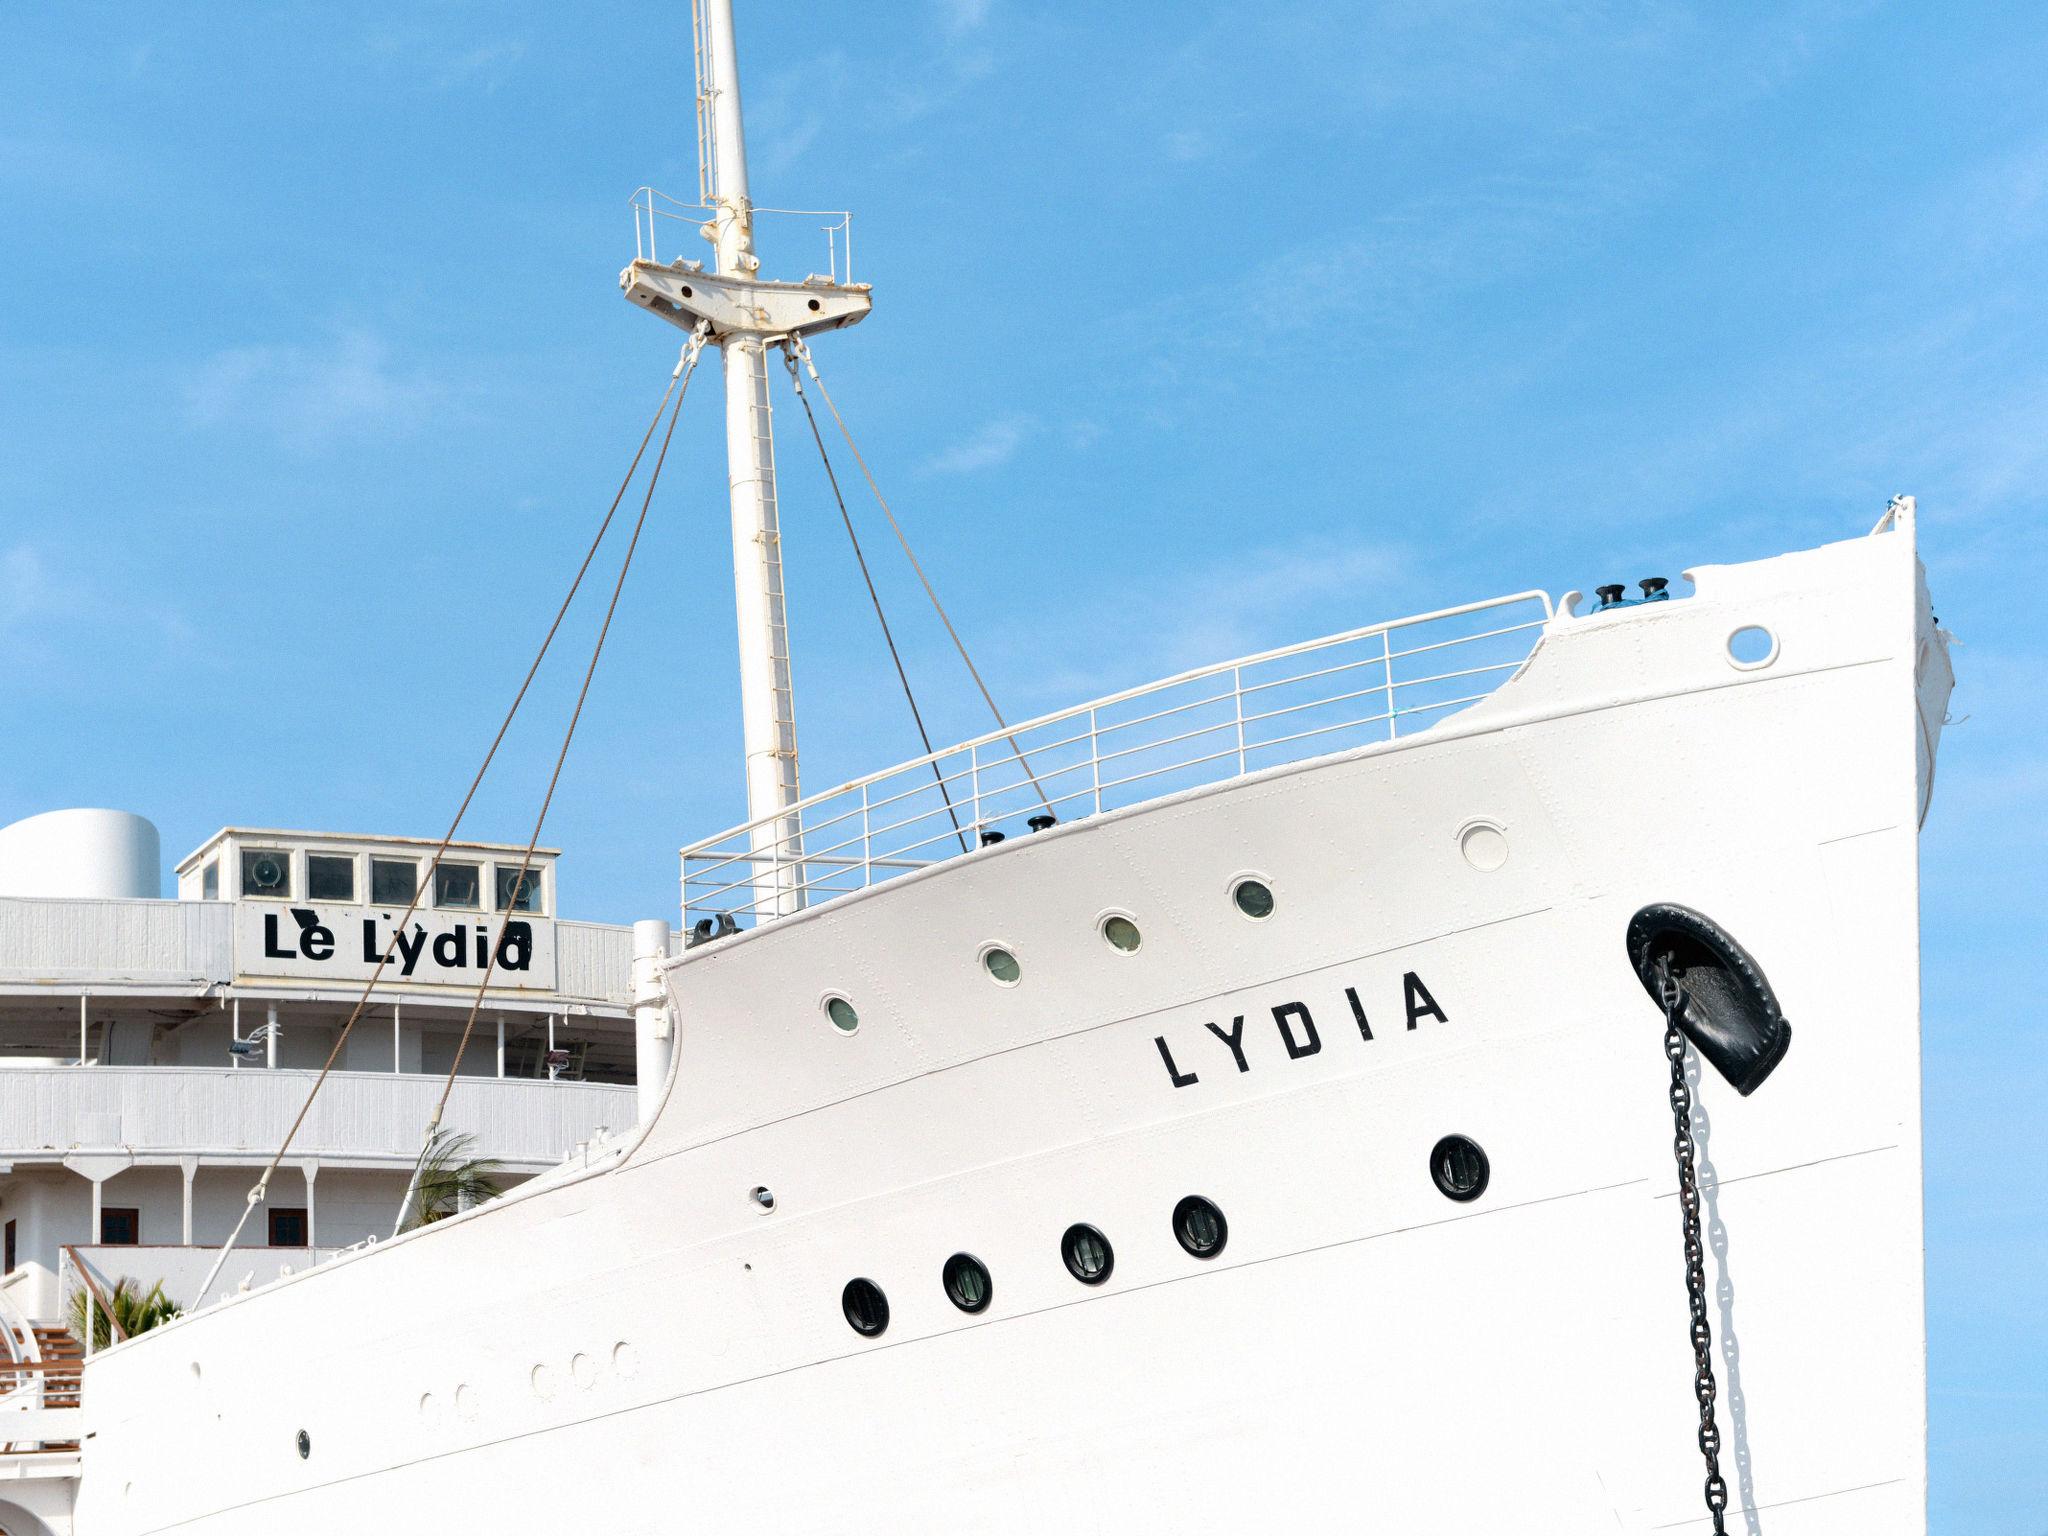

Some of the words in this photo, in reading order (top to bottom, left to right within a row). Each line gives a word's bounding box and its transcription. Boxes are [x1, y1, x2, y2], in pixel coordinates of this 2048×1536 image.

[264, 912, 335, 961] Le
[363, 919, 532, 976] Lydia
[1154, 971, 1449, 1088] LYDIA
